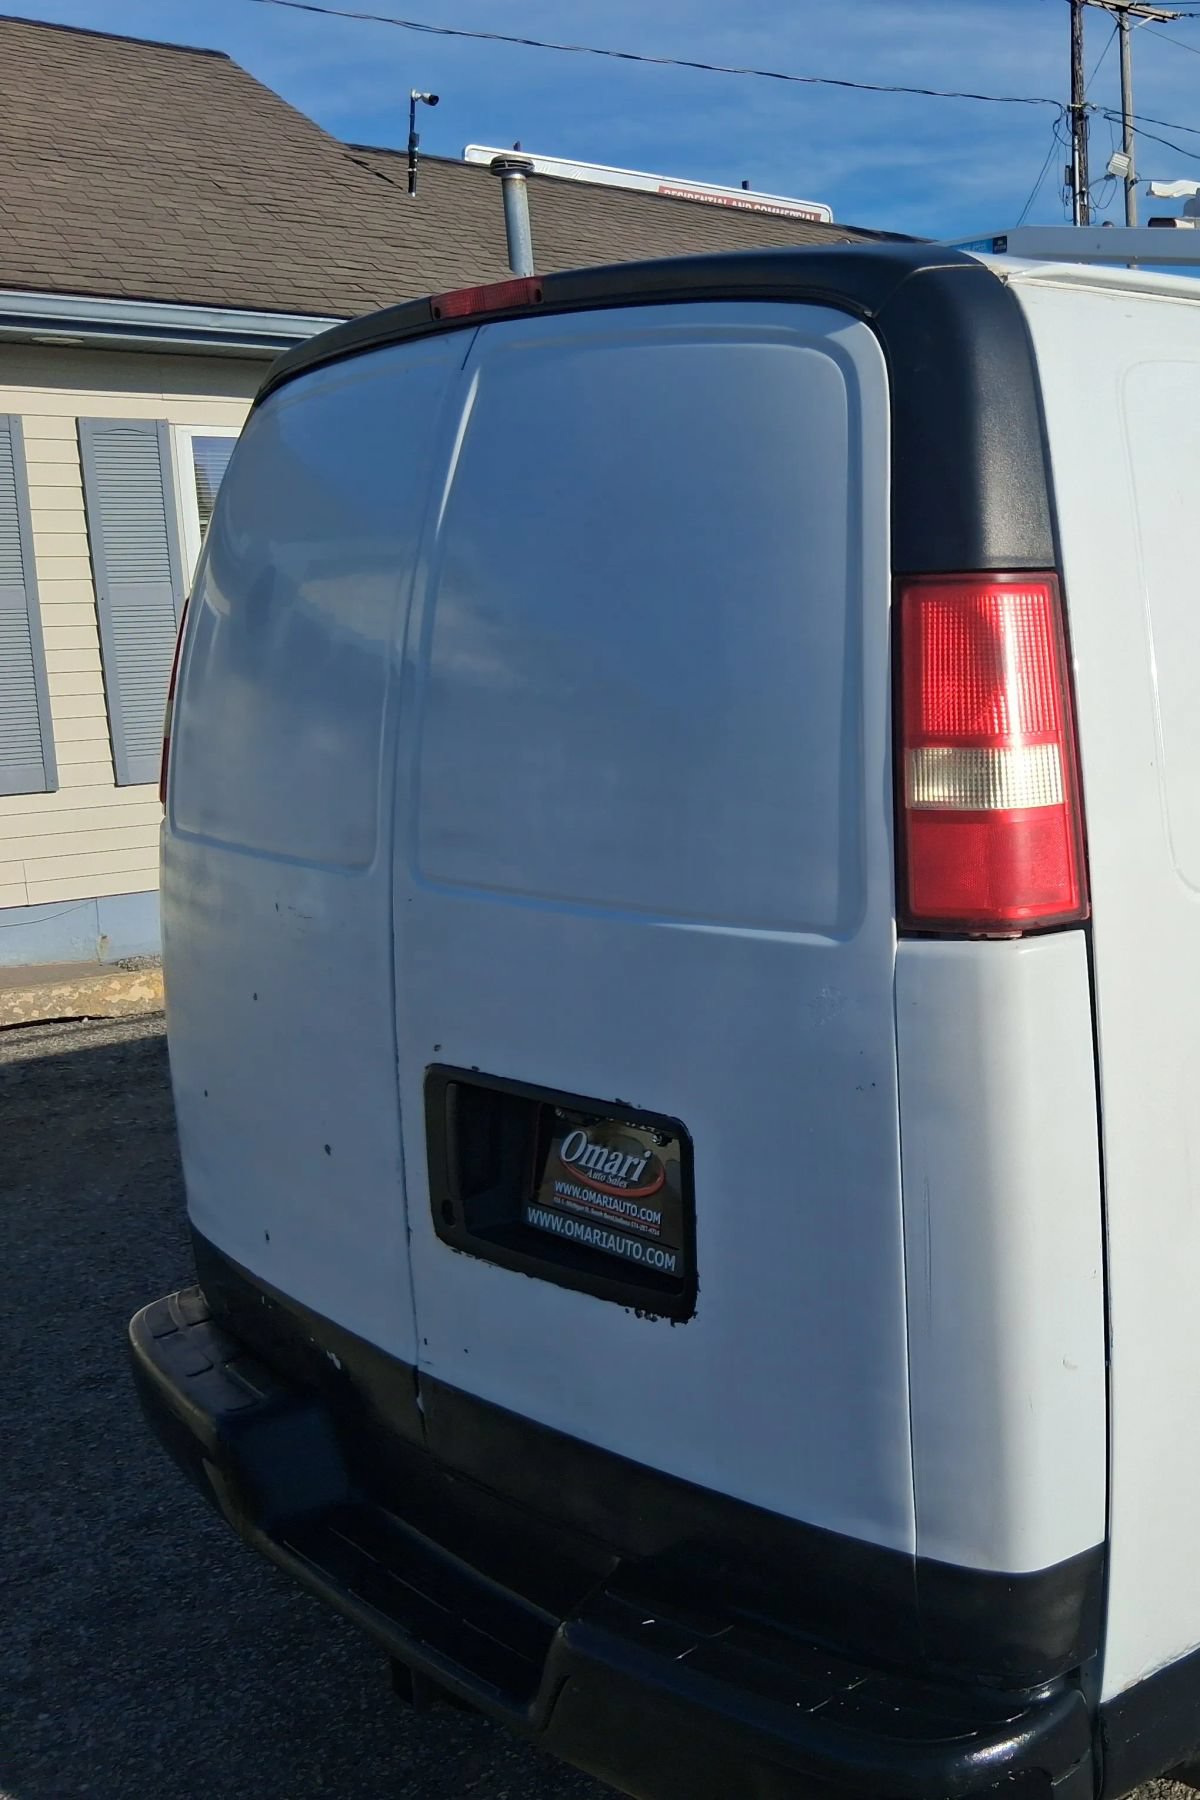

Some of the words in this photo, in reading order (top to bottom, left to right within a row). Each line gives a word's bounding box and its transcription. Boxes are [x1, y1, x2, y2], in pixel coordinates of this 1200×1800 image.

[560, 1130, 652, 1182] Omari
[586, 1170, 606, 1182] Auto
[606, 1174, 628, 1188] Sales
[554, 1181, 661, 1224] WWW.OMARIAUTO.COM
[527, 1207, 676, 1272] WWW.OMARIAUTO.COM
